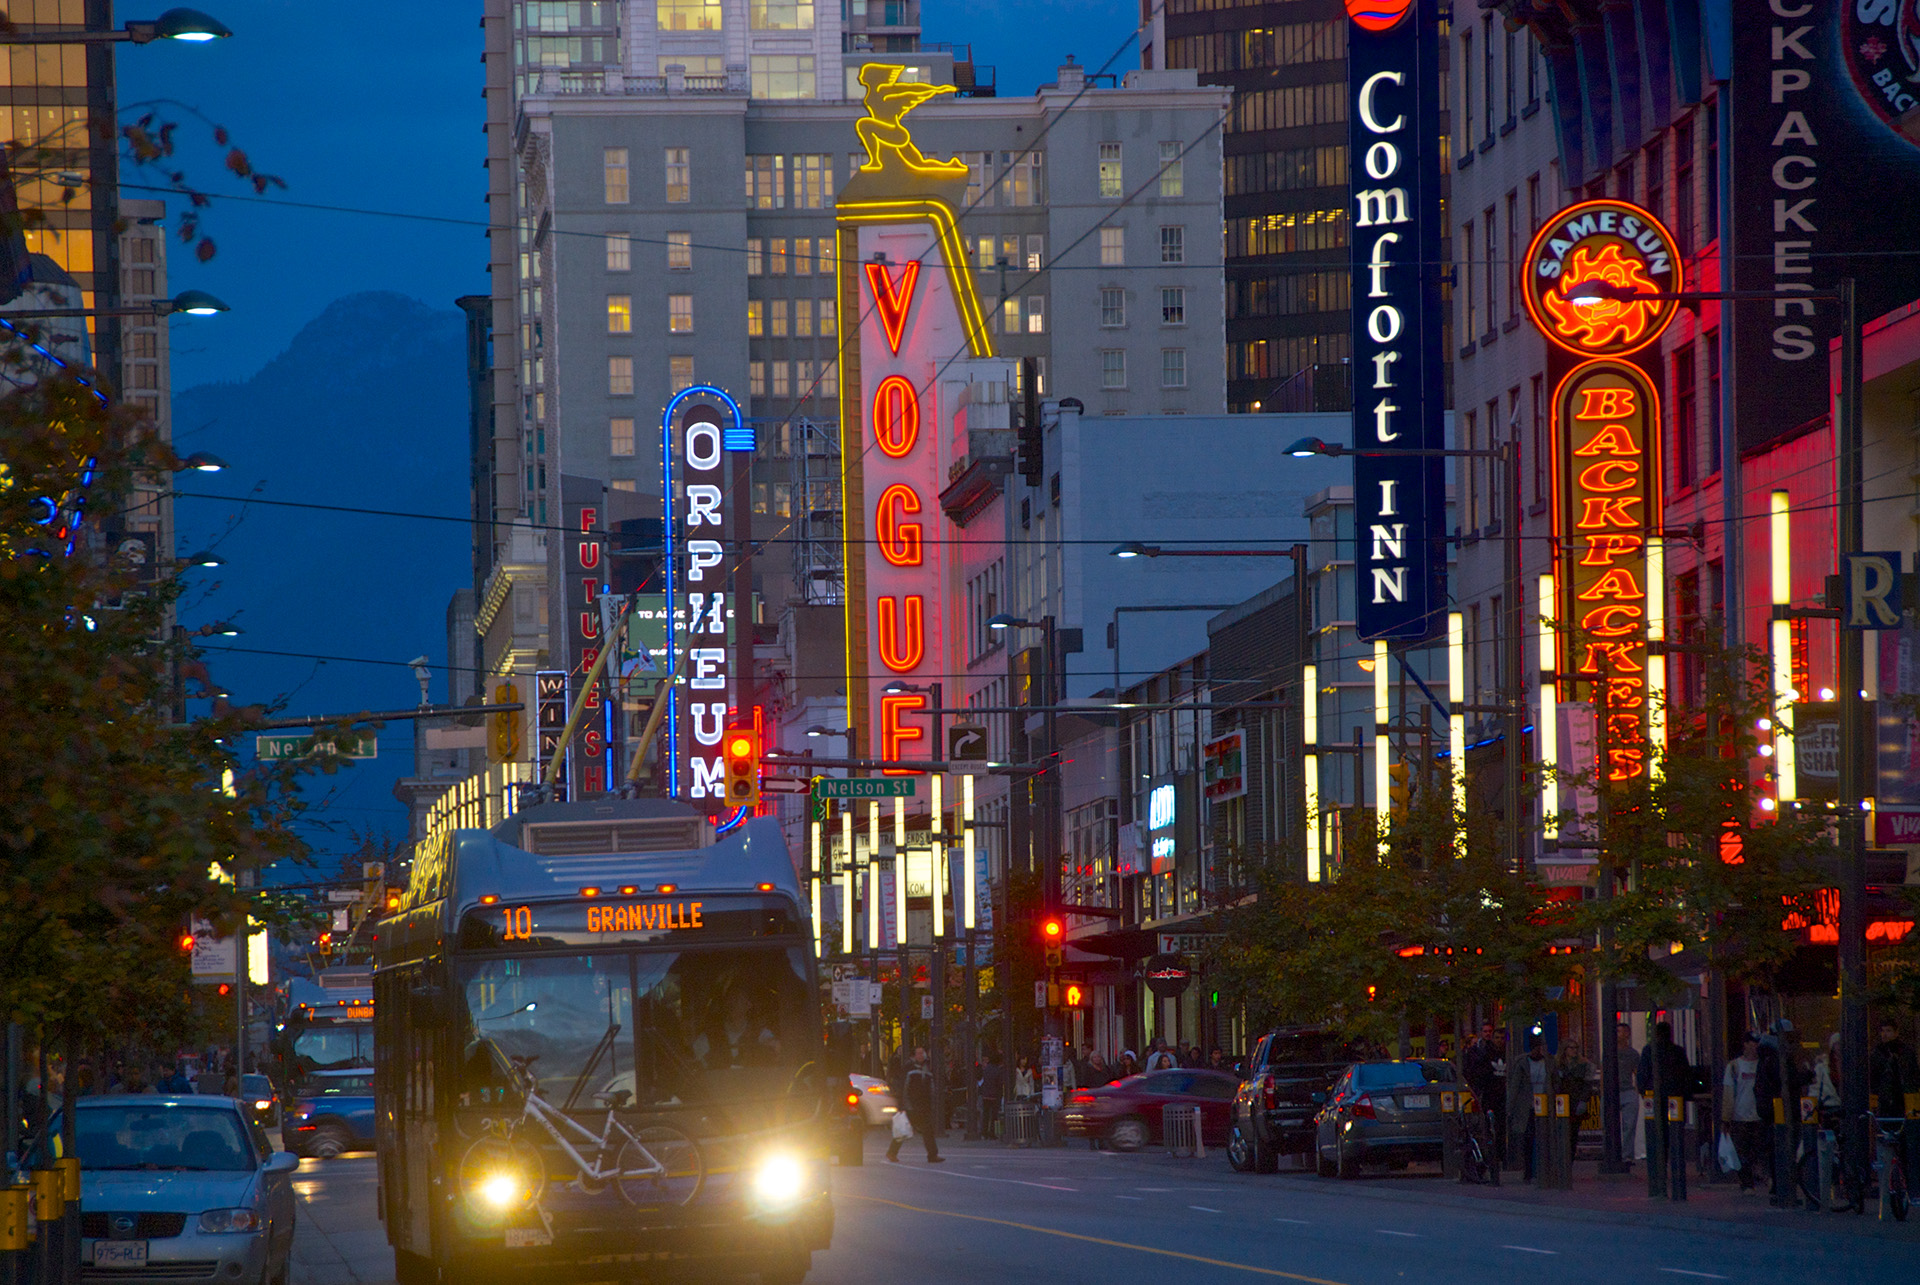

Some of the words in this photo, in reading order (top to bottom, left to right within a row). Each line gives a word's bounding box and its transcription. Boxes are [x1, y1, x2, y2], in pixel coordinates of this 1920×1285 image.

[1355, 70, 1410, 444] Comfort
[1538, 211, 1671, 279] SAMESUN
[864, 259, 926, 776] VOGUE
[578, 507, 600, 709] FUTURE
[685, 421, 727, 799] ORPHEUM
[1848, 555, 1900, 626] R
[269, 739, 337, 757] Nelon
[827, 781, 885, 796] Nelson
[892, 780, 909, 795] St
[502, 905, 532, 941] 10
[587, 902, 703, 933] GRANVILLE
[307, 1007, 315, 1022] 7
[346, 1006, 374, 1019] DUNBA
